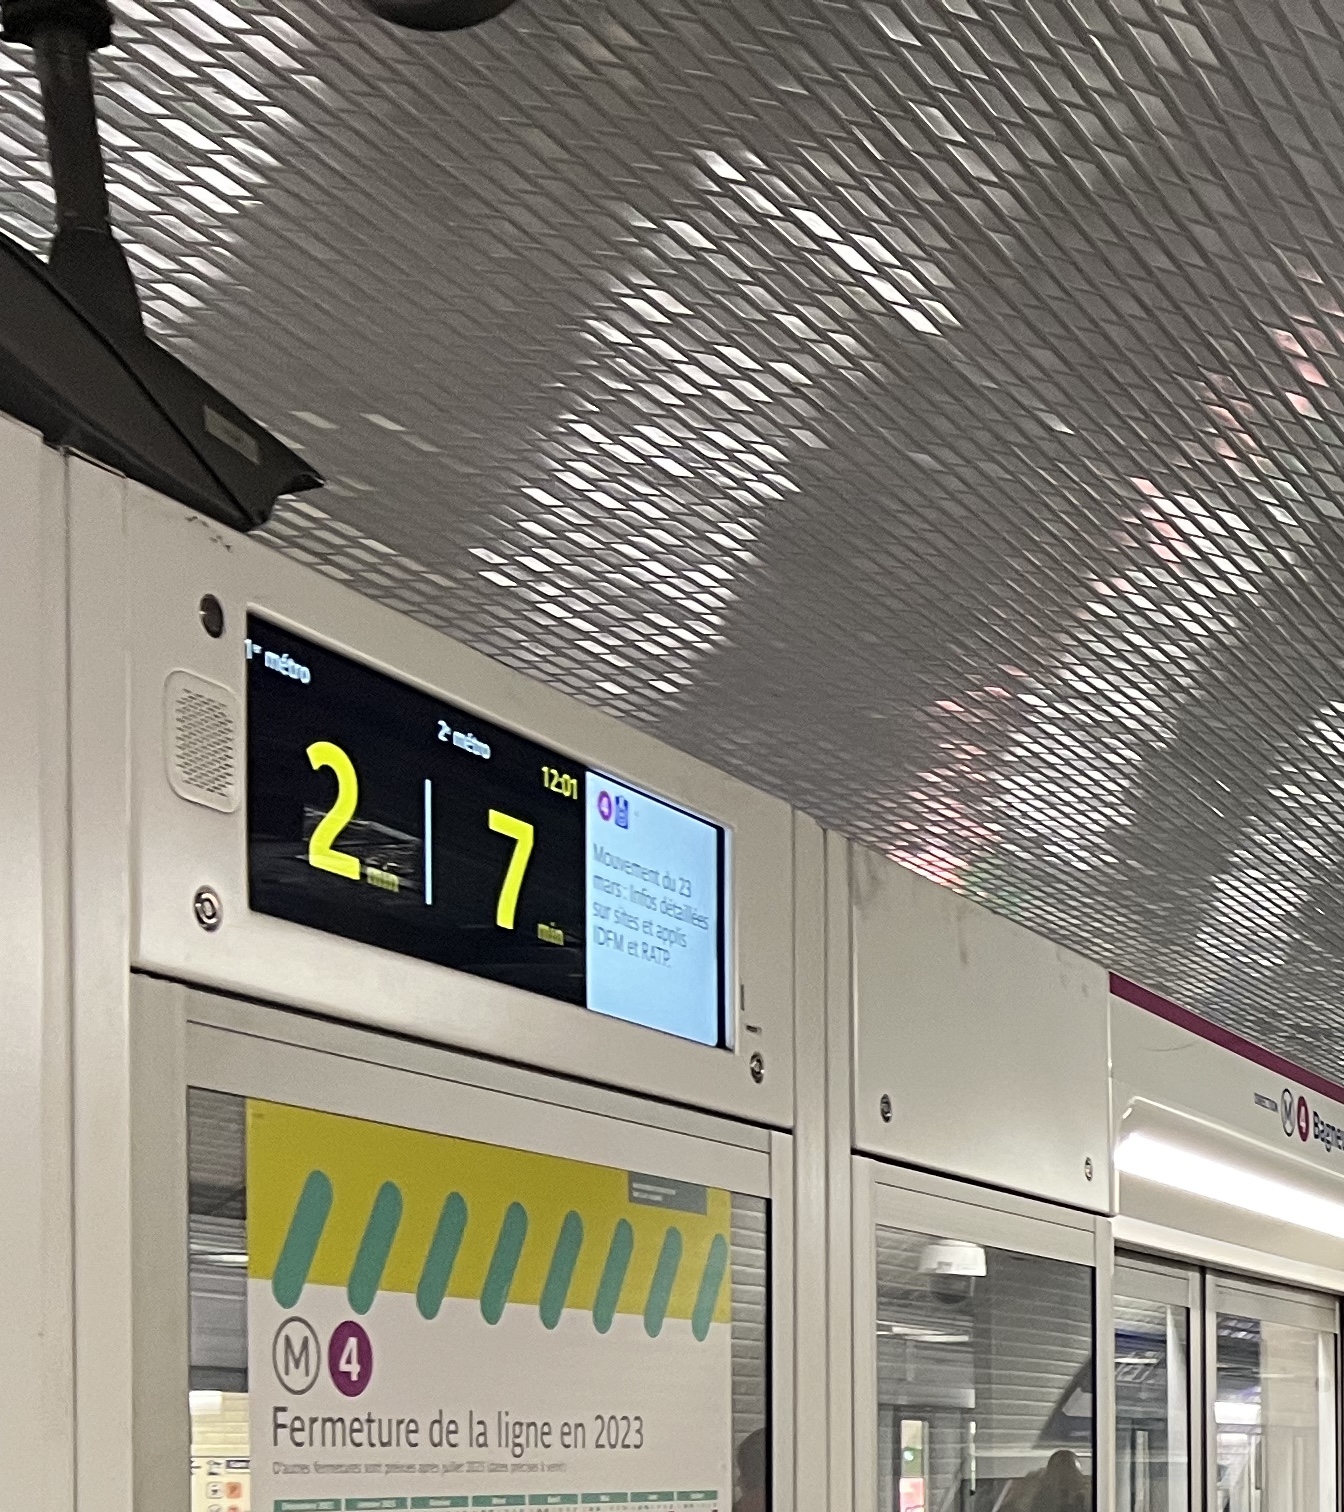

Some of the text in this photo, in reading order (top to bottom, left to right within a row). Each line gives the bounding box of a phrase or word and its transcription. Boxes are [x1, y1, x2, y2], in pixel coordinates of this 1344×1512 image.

[265, 651, 311, 684] métro
[541, 766, 578, 799] 12:01
[305, 741, 360, 880] 2
[488, 808, 534, 929] 7
[593, 843, 692, 898] Mouvement du 23
[593, 901, 612, 920] sur
[614, 906, 640, 931] sites
[642, 919, 654, 937] et
[659, 896, 709, 930] détaillées
[627, 940, 640, 958] et
[339, 1336, 361, 1381] 4
[272, 1406, 644, 1458] Fermeture de la ligne en 2023
